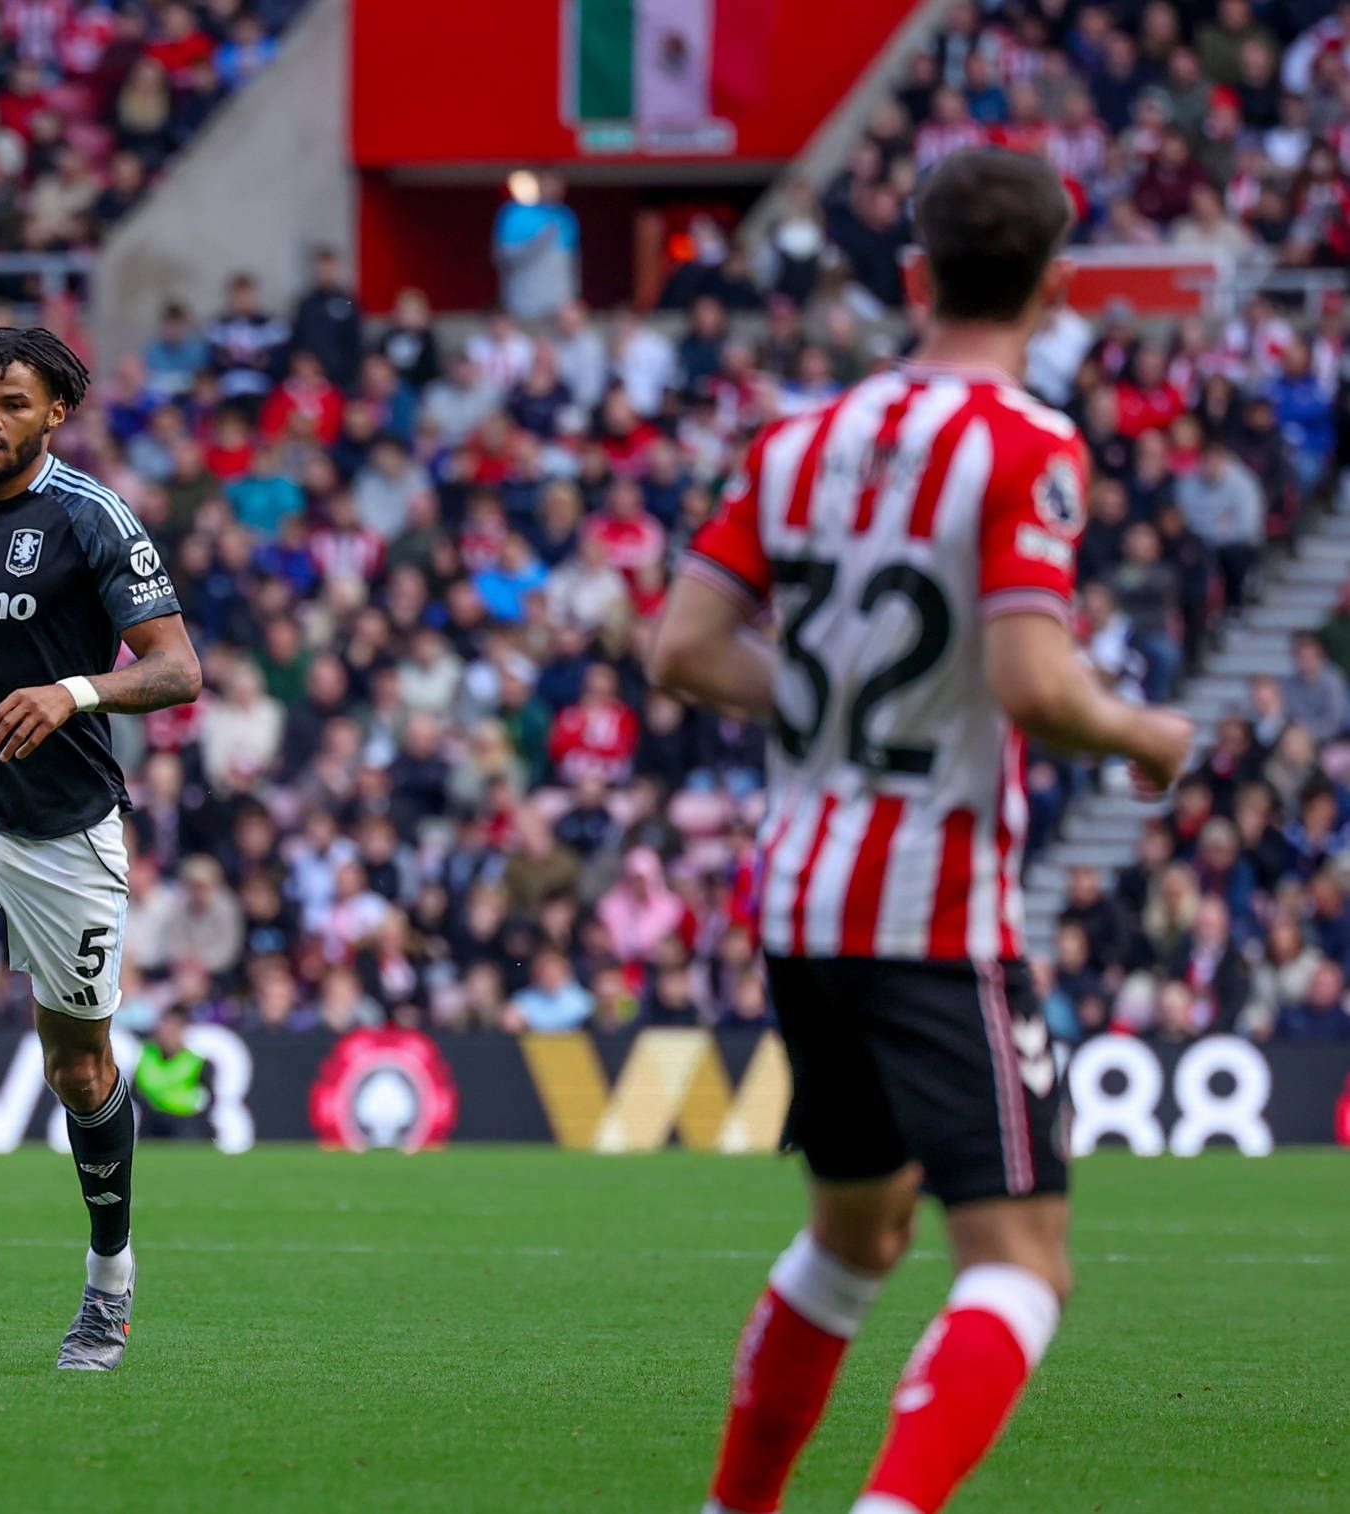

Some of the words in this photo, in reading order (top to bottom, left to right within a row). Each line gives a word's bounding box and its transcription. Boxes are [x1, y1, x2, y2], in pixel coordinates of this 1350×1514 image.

[128, 575, 171, 595] TRAD
[131, 585, 174, 605] NATIO
[767, 559, 950, 776] 32
[75, 927, 109, 979] 5
